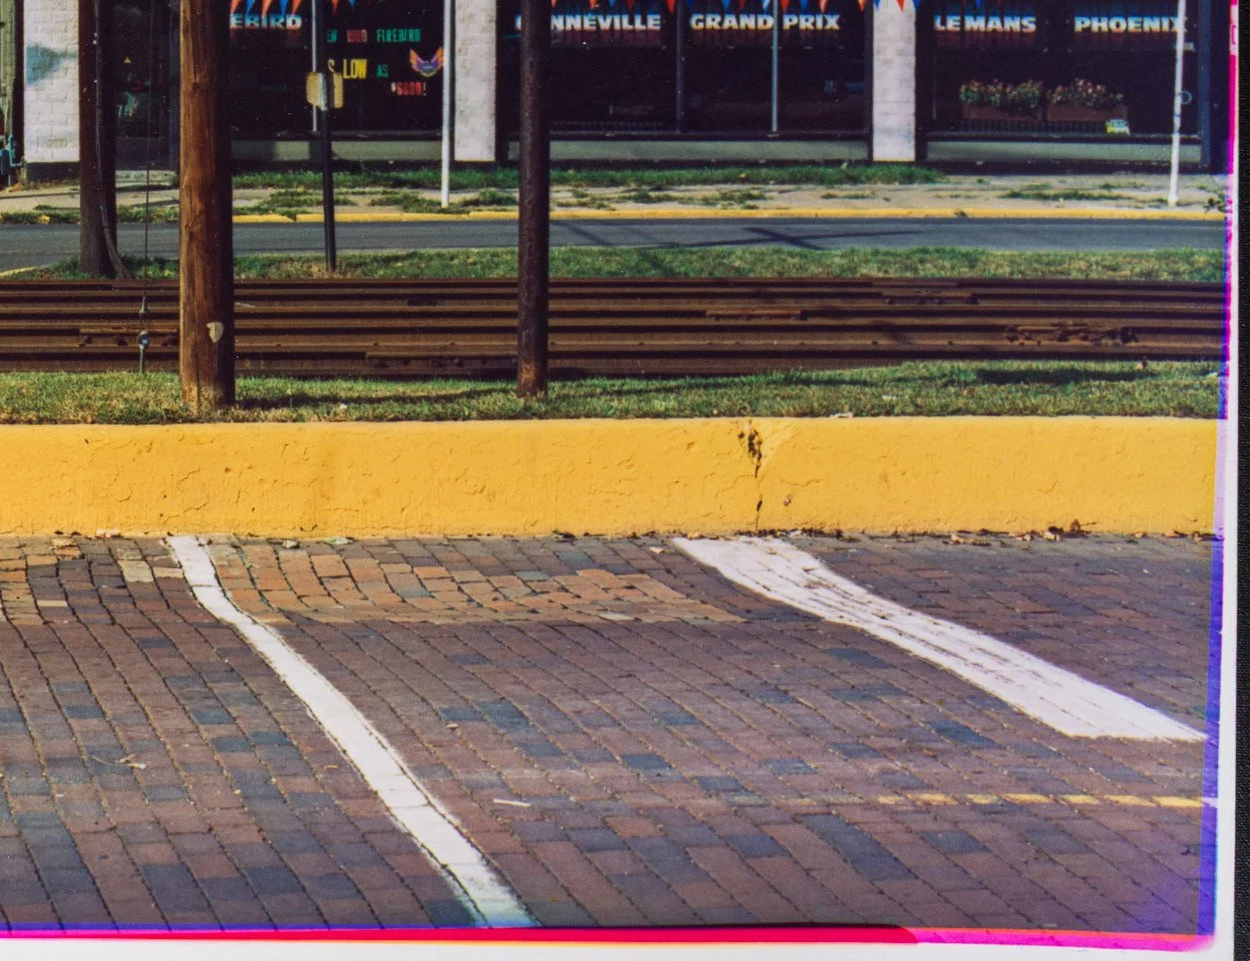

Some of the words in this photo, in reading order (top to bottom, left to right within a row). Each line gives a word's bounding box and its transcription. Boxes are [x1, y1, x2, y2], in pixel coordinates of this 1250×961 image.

[230, 14, 303, 29] EBIRD
[515, 13, 661, 31] NNEVILLE
[689, 13, 774, 30] GRAND
[782, 14, 841, 31] PRIX
[1073, 16, 1188, 32] PHOENIX
[376, 28, 421, 43] FIREBIRD
[343, 58, 368, 79] LOW
[376, 63, 389, 78] AS
